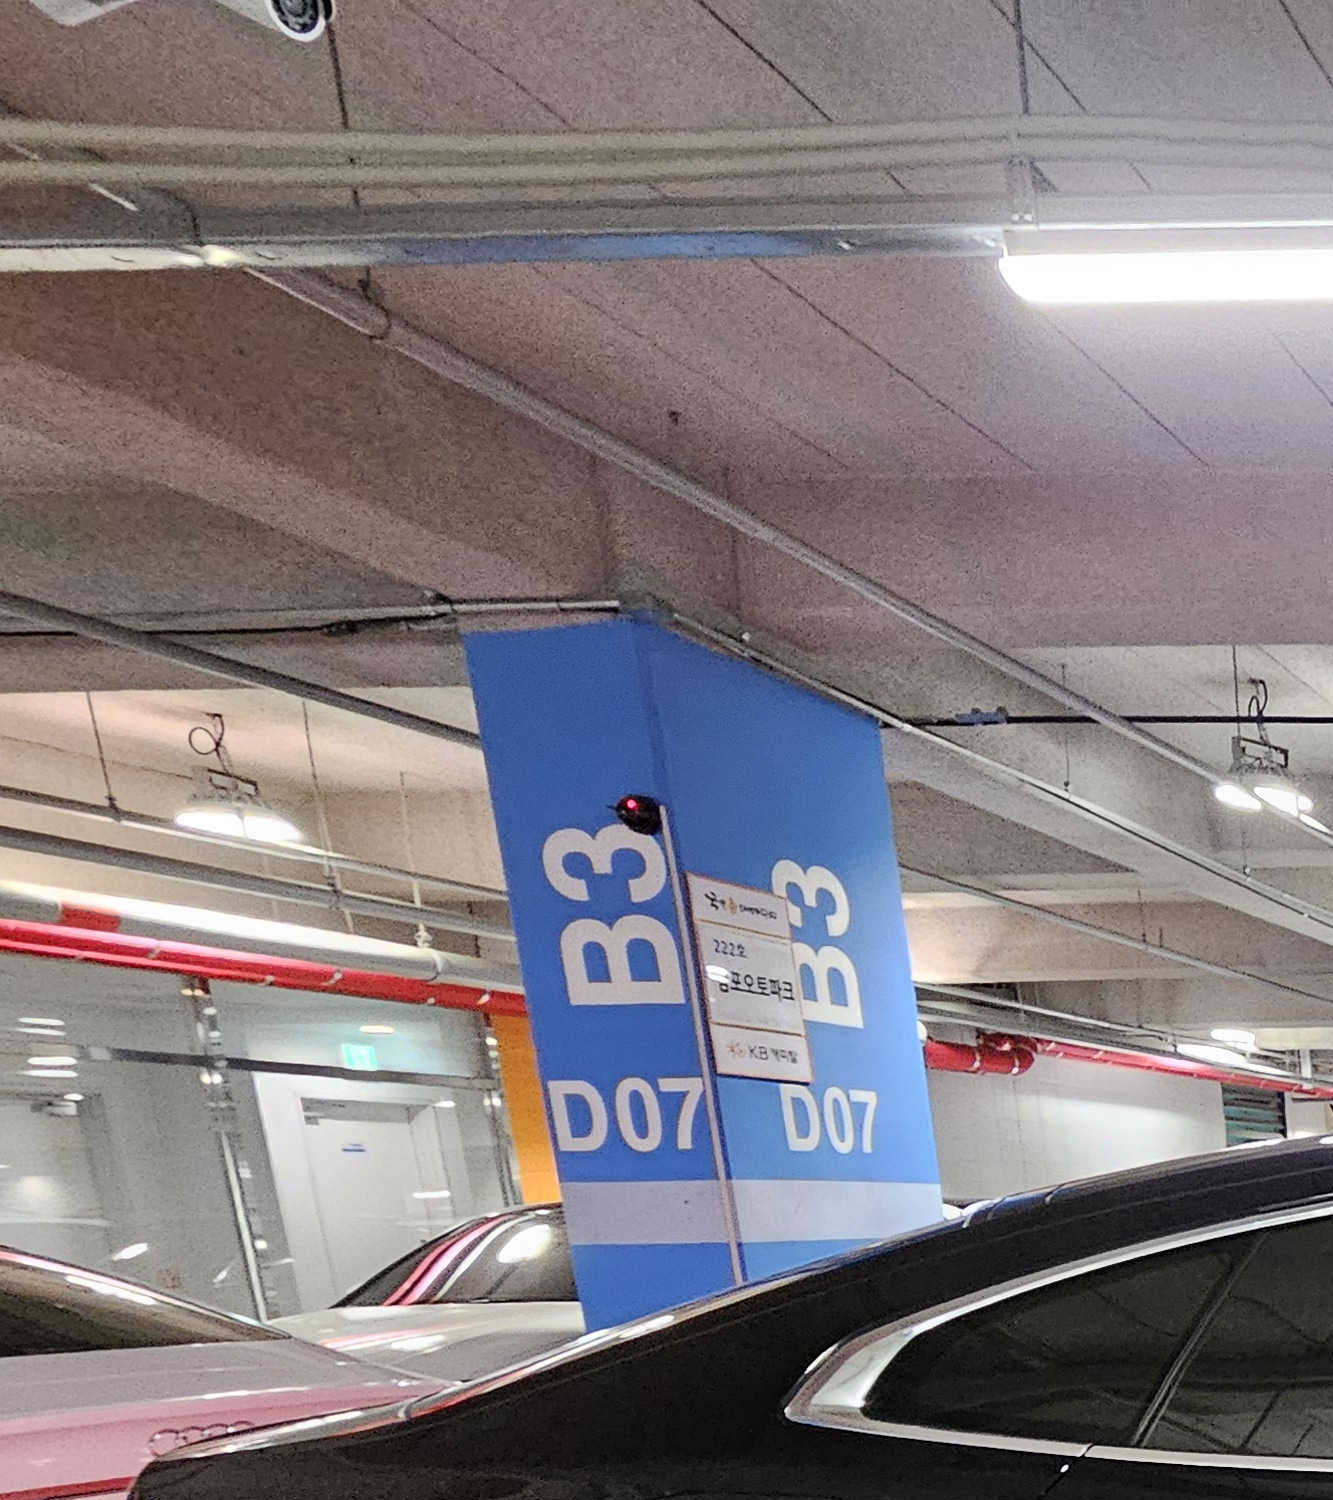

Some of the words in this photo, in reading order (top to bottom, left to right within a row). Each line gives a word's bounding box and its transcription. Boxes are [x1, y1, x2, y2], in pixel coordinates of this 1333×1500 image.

[542, 823, 686, 1005] B3
[771, 859, 864, 1028] B3
[547, 1077, 704, 1152] D07
[780, 1083, 878, 1153] D07
